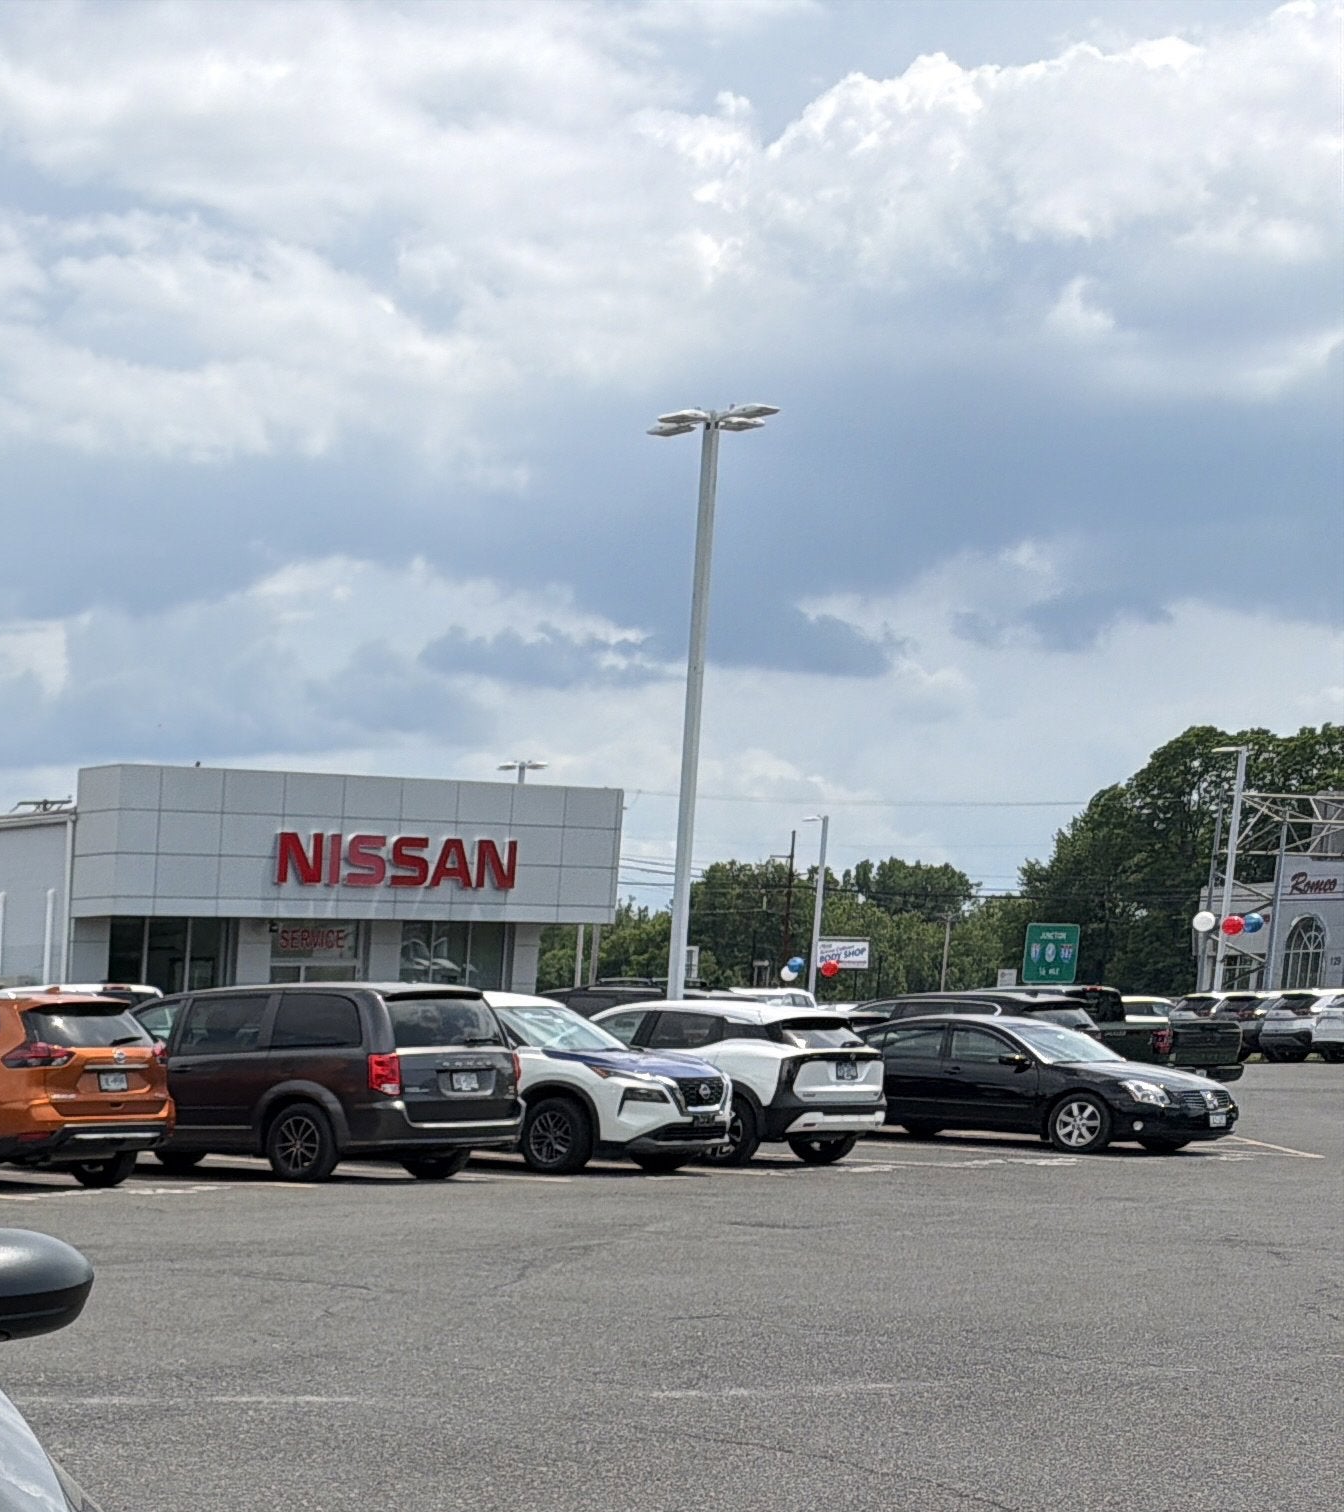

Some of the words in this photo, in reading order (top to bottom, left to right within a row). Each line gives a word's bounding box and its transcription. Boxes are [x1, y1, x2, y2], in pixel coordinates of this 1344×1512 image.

[276, 832, 517, 890] NISSAN
[1289, 871, 1338, 895] Romeo
[279, 928, 346, 949] SERVICE
